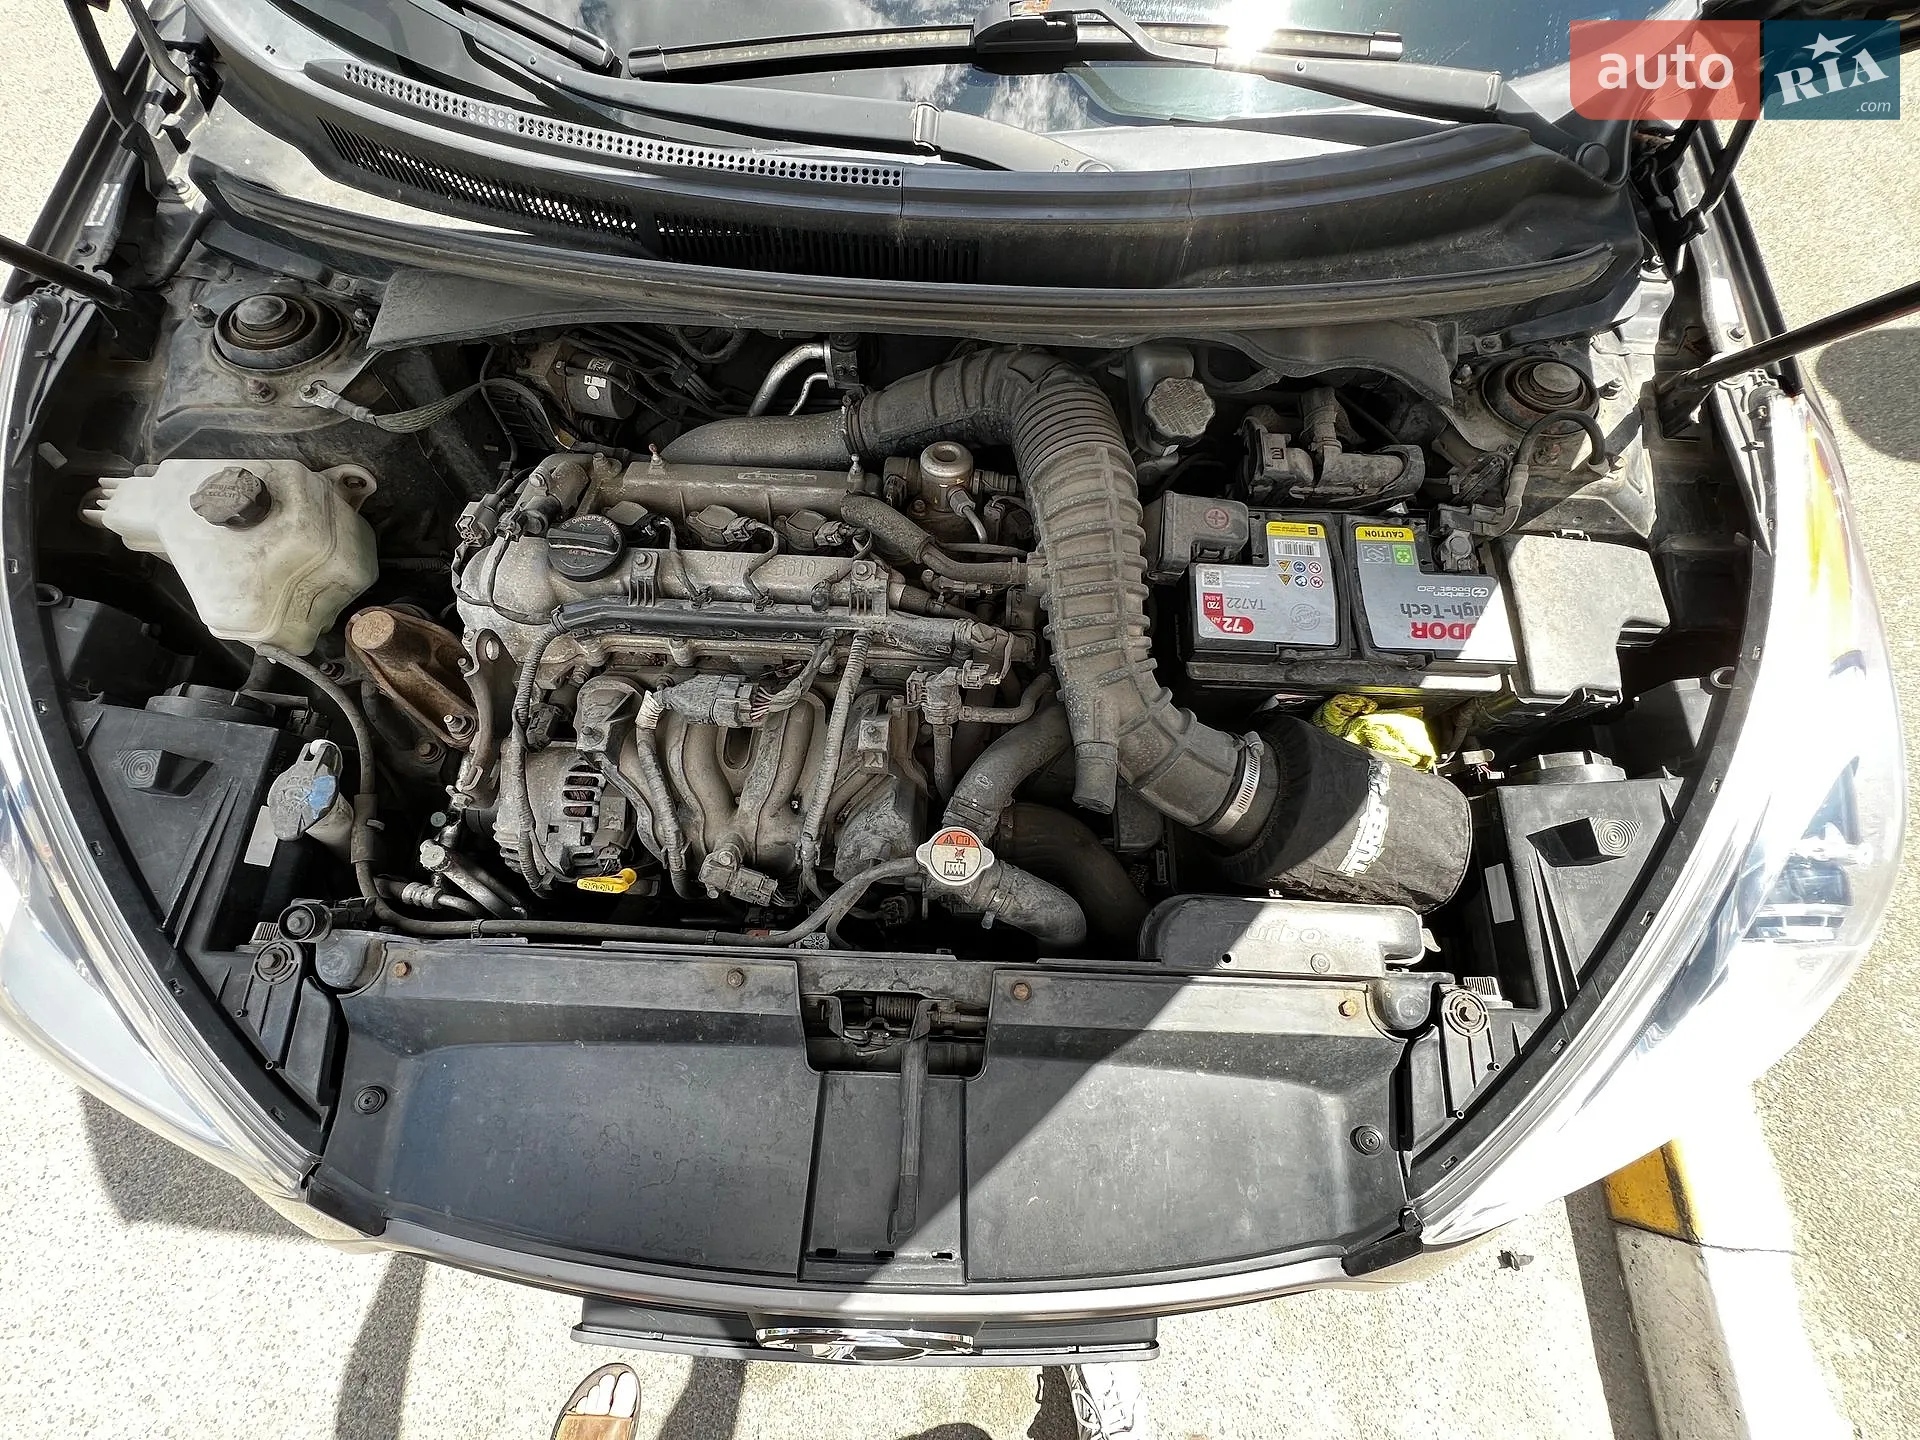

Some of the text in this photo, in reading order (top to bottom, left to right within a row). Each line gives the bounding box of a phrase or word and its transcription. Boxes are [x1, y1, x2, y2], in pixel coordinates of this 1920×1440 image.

[571, 514, 602, 524] OWNER'S
[1364, 530, 1404, 538] CAUTION
[1207, 601, 1220, 609] 720
[1225, 597, 1266, 611] TA722
[1222, 617, 1243, 632] 72
